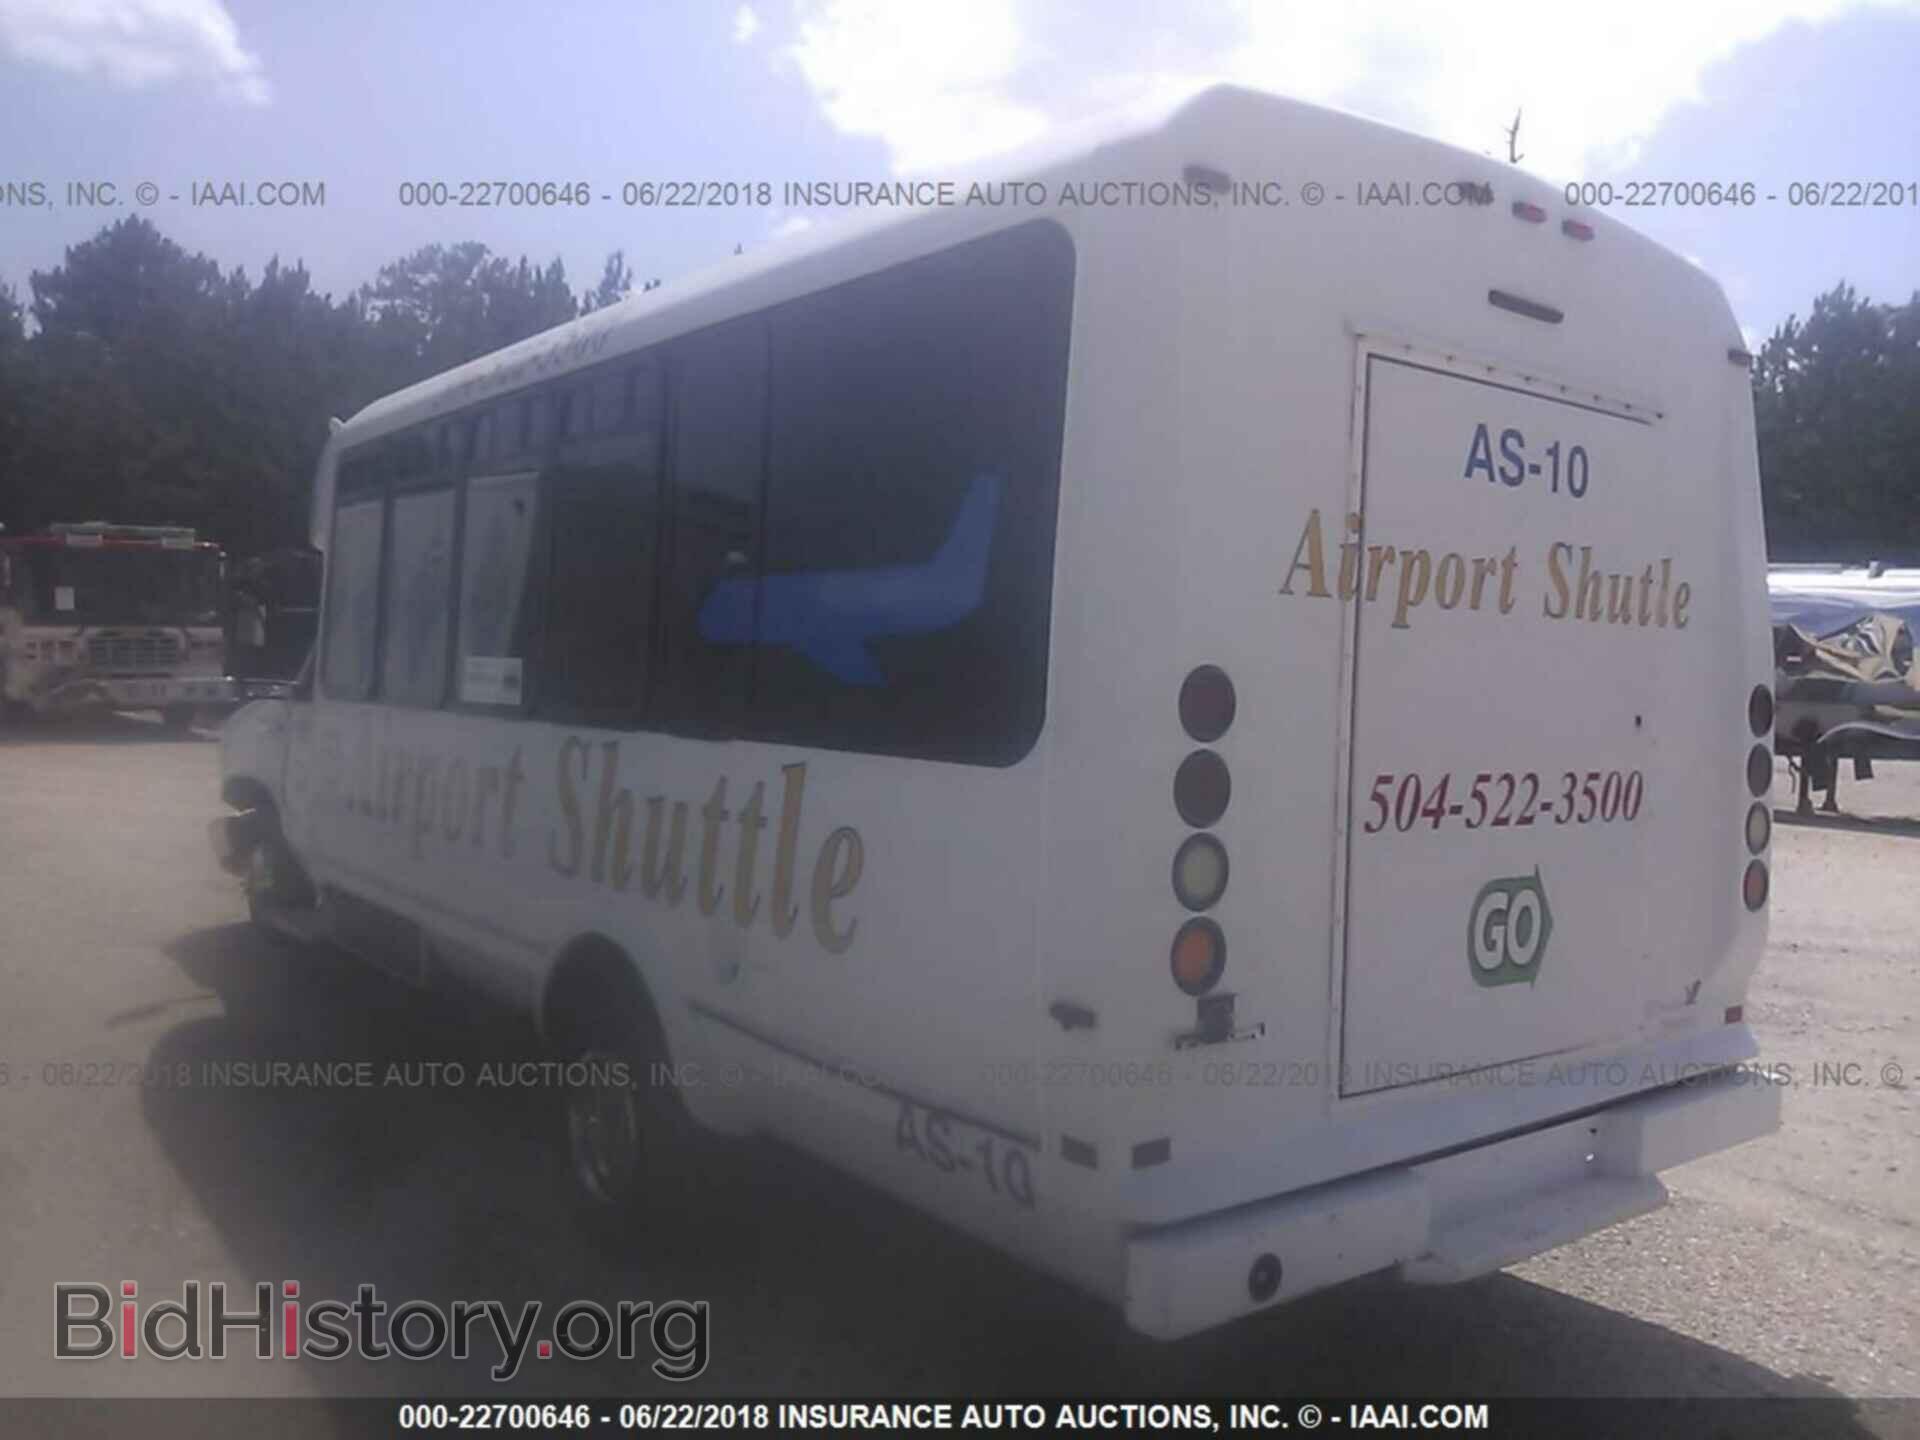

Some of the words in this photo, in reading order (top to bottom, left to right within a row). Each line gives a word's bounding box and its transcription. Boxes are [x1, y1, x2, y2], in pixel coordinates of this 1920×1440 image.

[1463, 423, 1590, 499] AS-10
[1278, 508, 1519, 629] Airport
[1543, 541, 1692, 630] Shutle
[548, 735, 865, 955] Shuttle
[1362, 770, 1644, 834] 504-522-3500
[1473, 888, 1542, 971] GO
[896, 1100, 1036, 1213] AS-10
